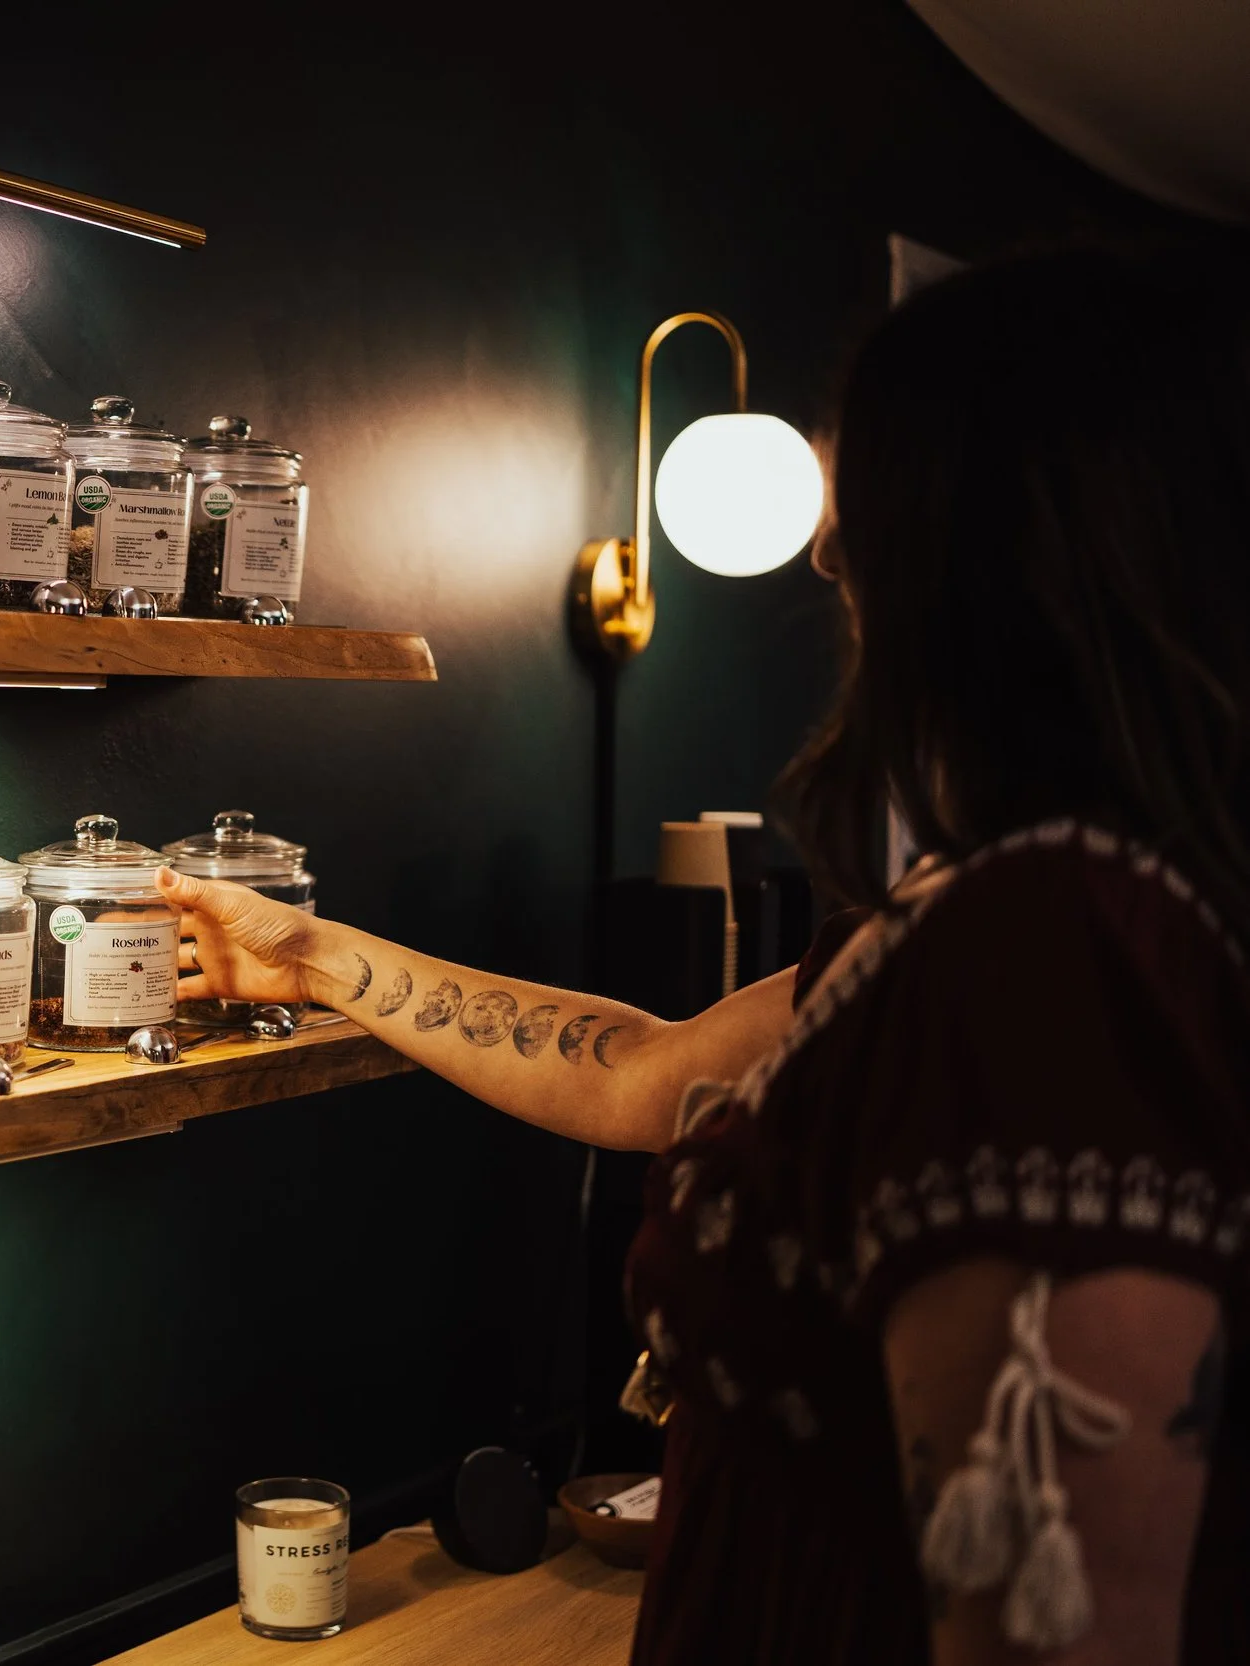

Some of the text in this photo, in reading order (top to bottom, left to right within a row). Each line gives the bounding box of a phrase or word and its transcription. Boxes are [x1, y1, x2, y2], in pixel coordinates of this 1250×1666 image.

[26, 488, 58, 501] Lemon
[83, 486, 104, 494] USDA
[81, 496, 107, 504] ORGANIC
[118, 504, 187, 516] Marshmallow Ro
[56, 915, 76, 925] USDA
[112, 936, 159, 949] Rosehips
[266, 1535, 349, 1558] STRESS RE
